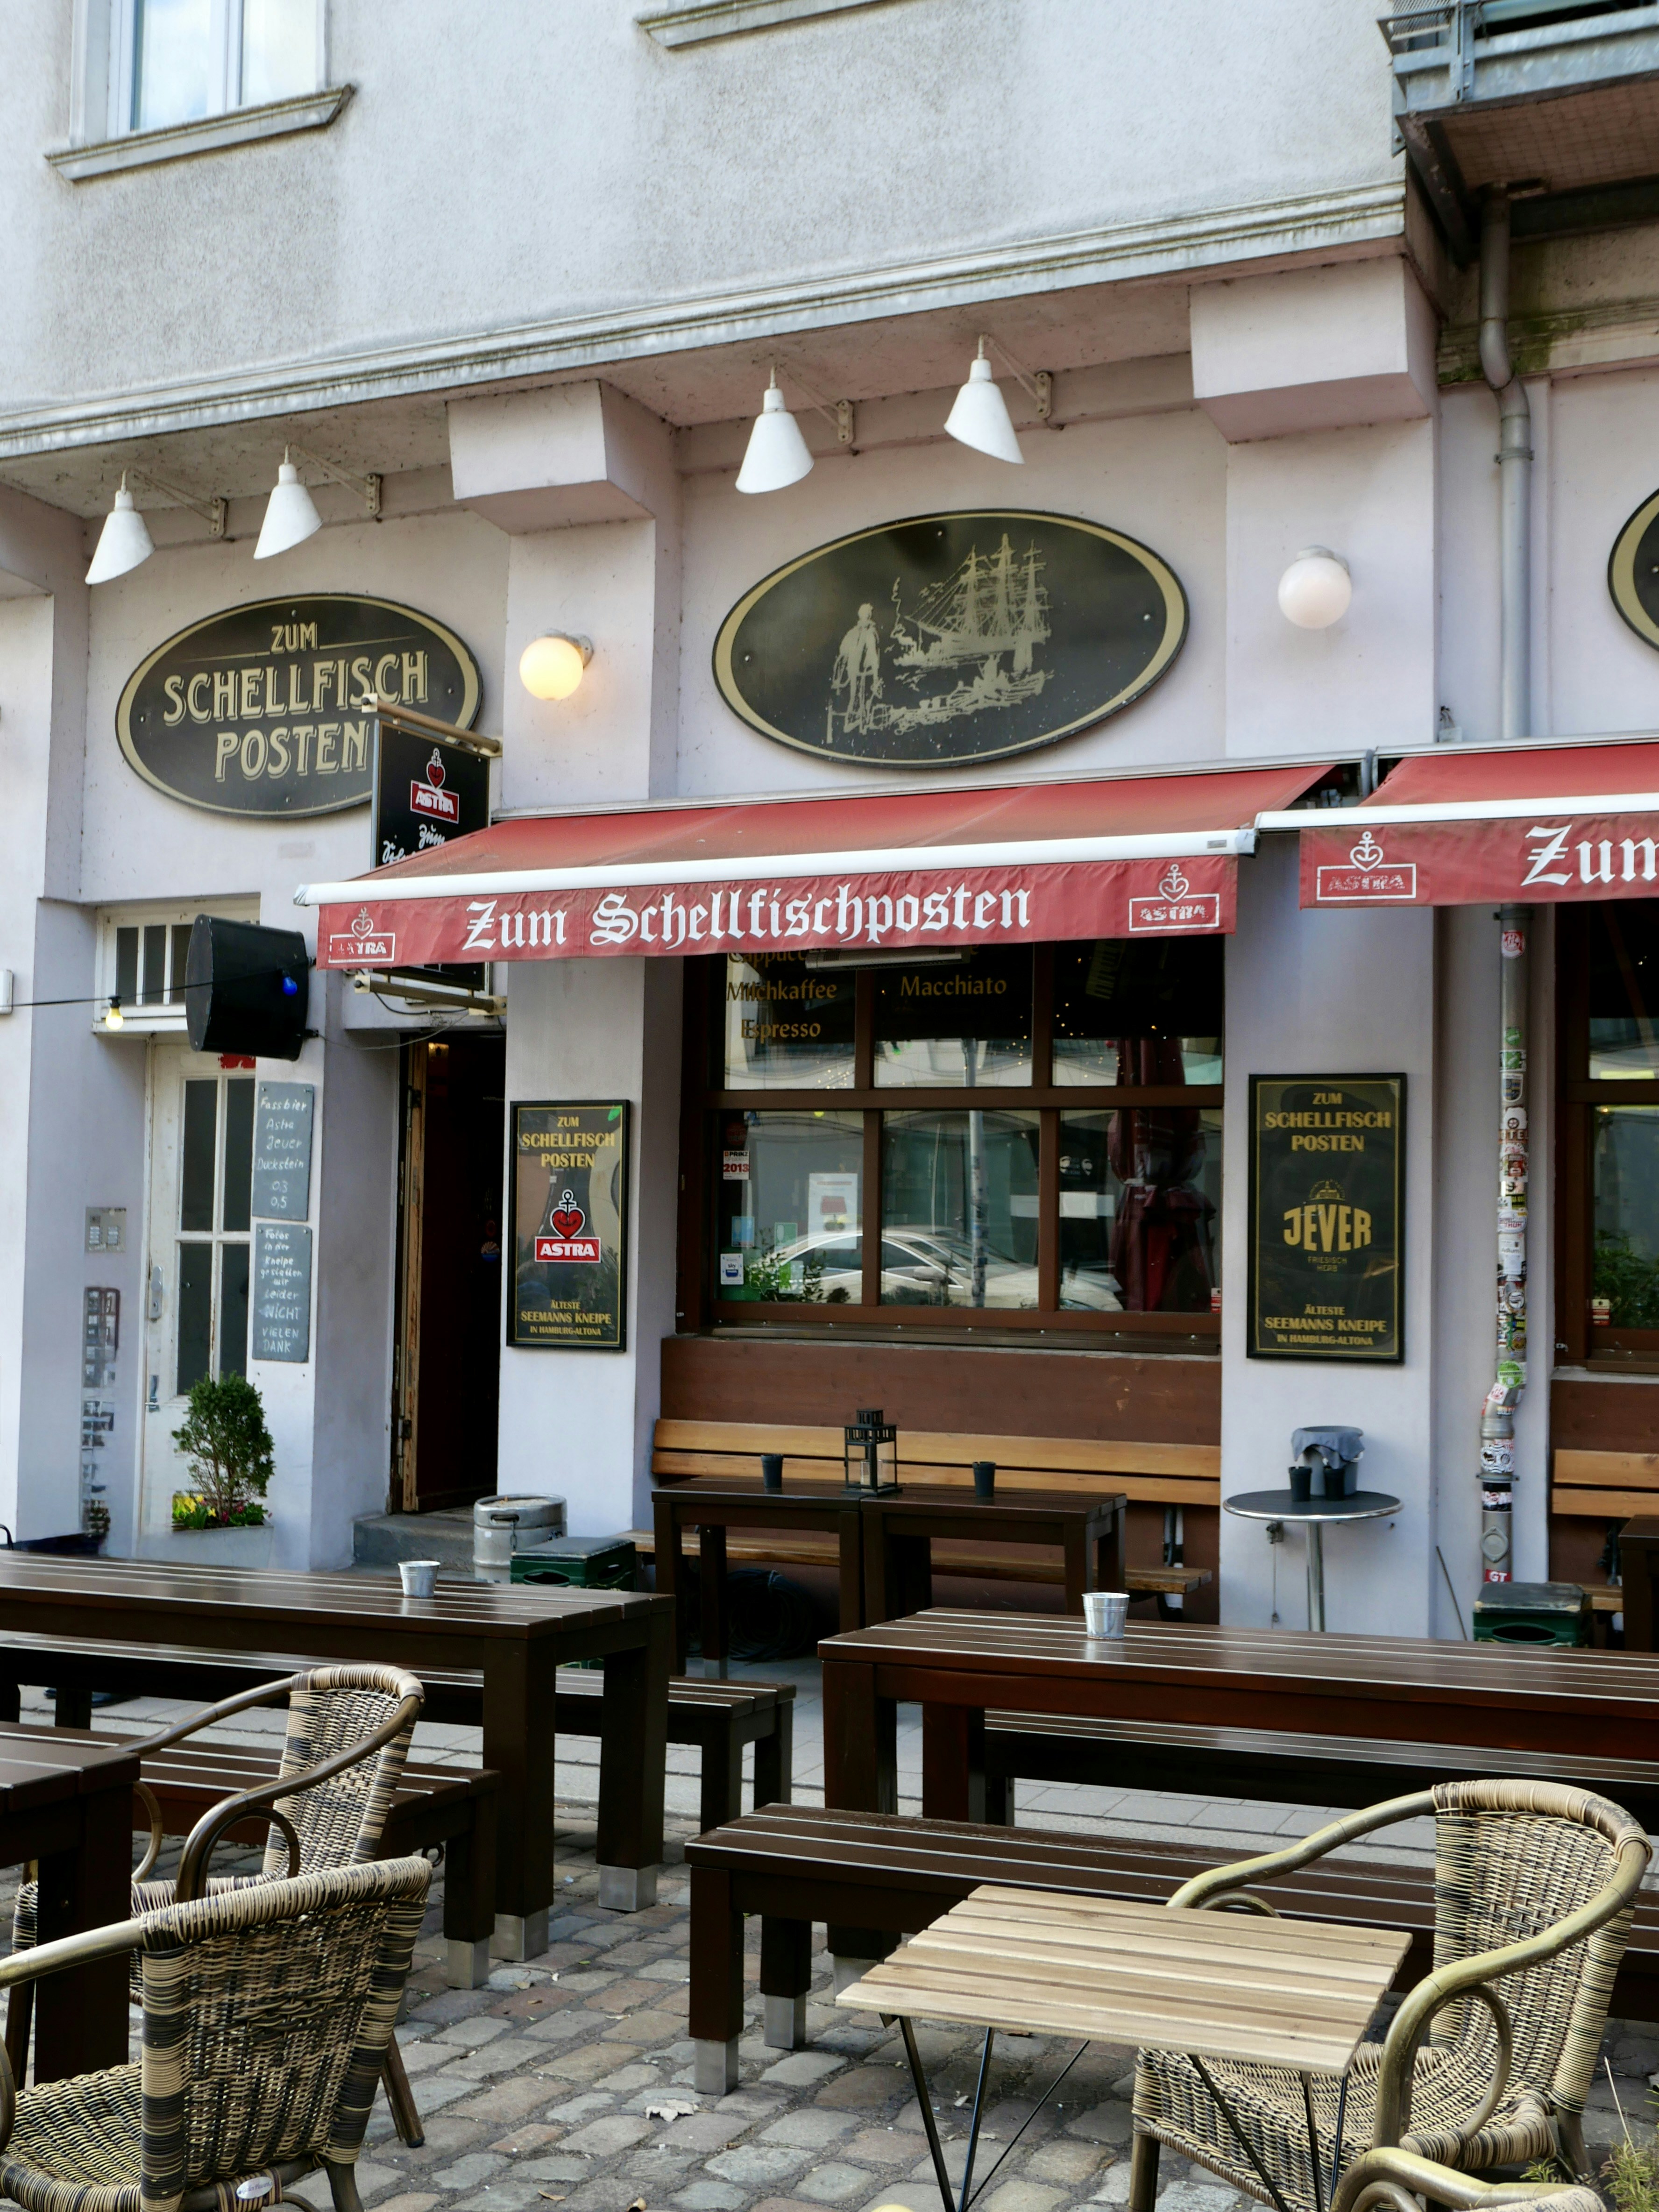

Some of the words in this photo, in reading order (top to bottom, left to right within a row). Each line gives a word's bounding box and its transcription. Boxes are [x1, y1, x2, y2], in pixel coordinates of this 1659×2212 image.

[270, 622, 319, 654] ZUM
[163, 650, 429, 726] SCHELLFISCH
[215, 720, 369, 782] POSTEN
[415, 790, 454, 815] ASTRA
[461, 899, 567, 950] Zum
[589, 882, 1031, 951] Schellfischposten
[727, 979, 837, 1001] Milchkaffee
[900, 974, 1007, 996] Macchiato
[741, 1019, 821, 1044] Espresso
[1312, 1092, 1342, 1106] ZUM
[266, 1118, 294, 1130] Astra
[557, 1116, 580, 1127] ZUM
[1265, 1111, 1391, 1129] SCHELLFISCH
[522, 1131, 615, 1149] SCHELLFISCH
[1291, 1134, 1365, 1152] POSTEN
[541, 1153, 596, 1169] POSTEN
[723, 1163, 750, 1173] 2013
[270, 1196, 288, 1209] 0,5
[1283, 1203, 1372, 1253] JEVER
[539, 1243, 596, 1257] ASTRA
[550, 1299, 581, 1311] ÄLTESTE
[1304, 1304, 1346, 1316] ÄLTESTE
[521, 1310, 573, 1324] SEEMANNS
[575, 1312, 612, 1325] KNEIPE
[1264, 1317, 1334, 1331] SEEMANNS
[1337, 1319, 1388, 1333] KNEIPE
[530, 1326, 538, 1334] IN
[539, 1326, 602, 1337] HAMBURG-ALTONA
[263, 1340, 291, 1353] DANK
[1277, 1334, 1288, 1343] IN
[1290, 1334, 1374, 1346] HAMBURG-ALTONA
